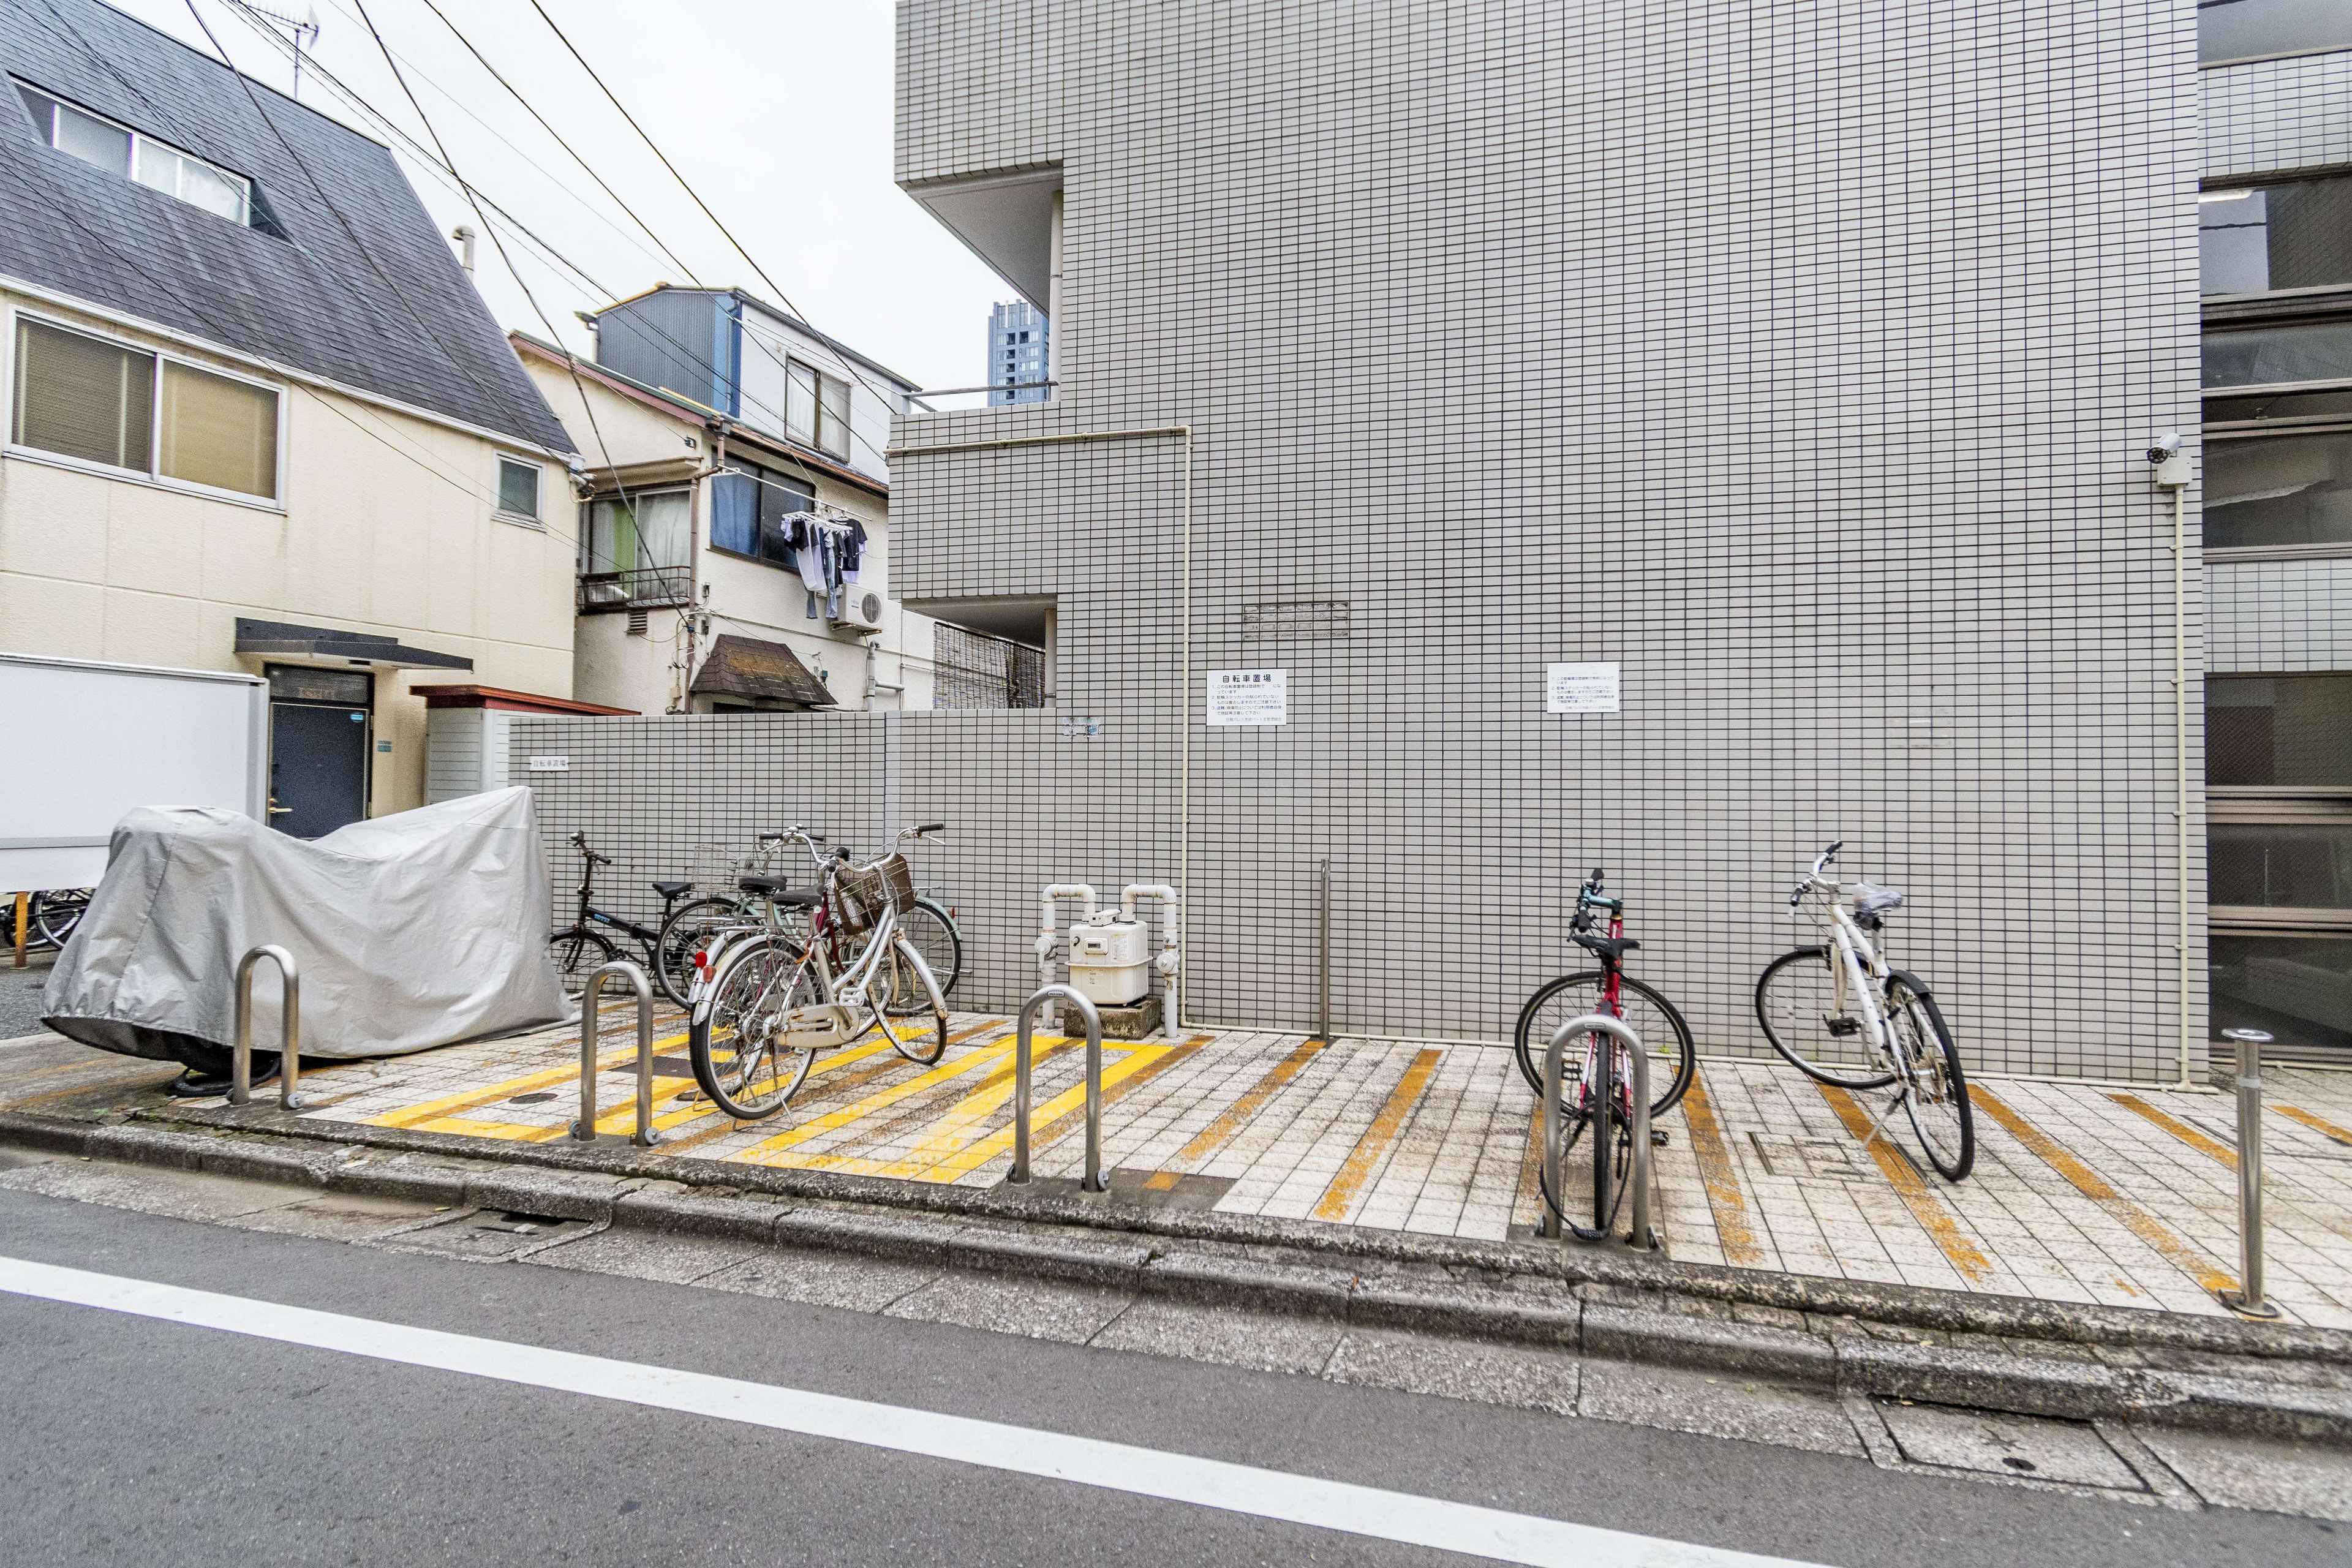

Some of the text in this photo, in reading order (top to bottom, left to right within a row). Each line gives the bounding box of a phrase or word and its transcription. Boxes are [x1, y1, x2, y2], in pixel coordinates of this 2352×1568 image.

[1223, 674, 1272, 683] 自転車置場
